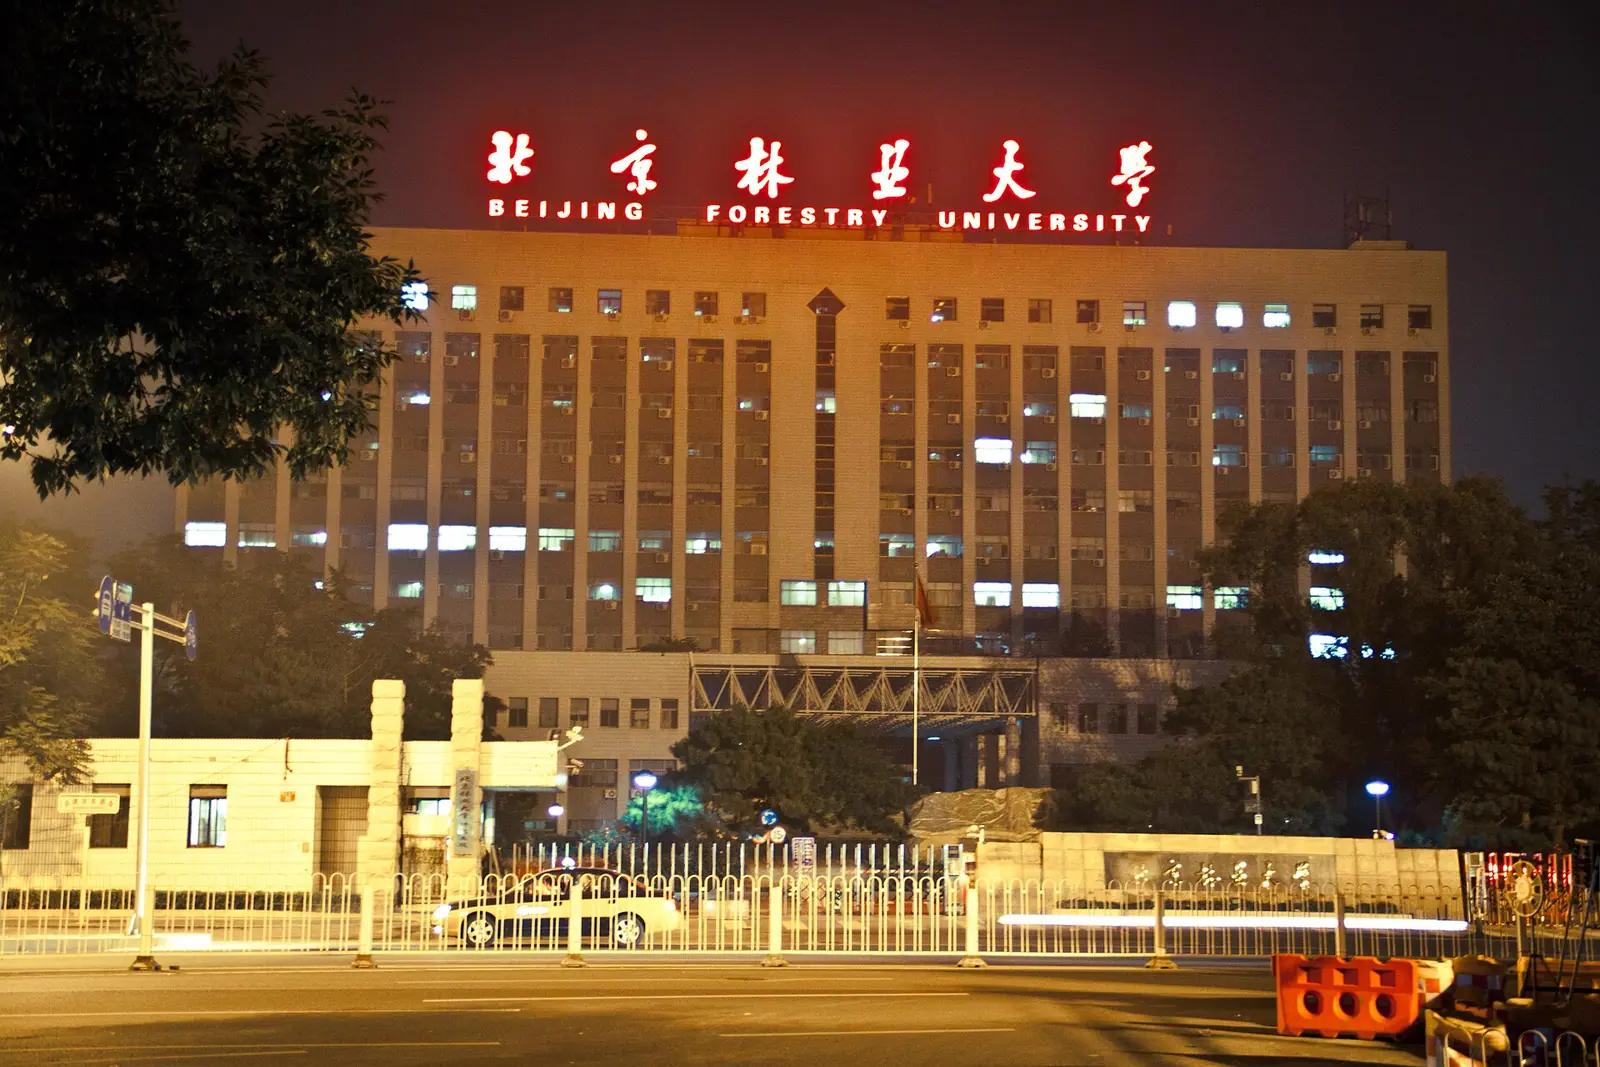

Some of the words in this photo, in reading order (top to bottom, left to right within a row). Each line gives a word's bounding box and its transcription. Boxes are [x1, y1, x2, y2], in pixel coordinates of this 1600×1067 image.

[488, 198, 643, 221] BEIJING
[706, 204, 887, 227] FORESTRY
[937, 210, 1151, 233] UNIVERSITY
